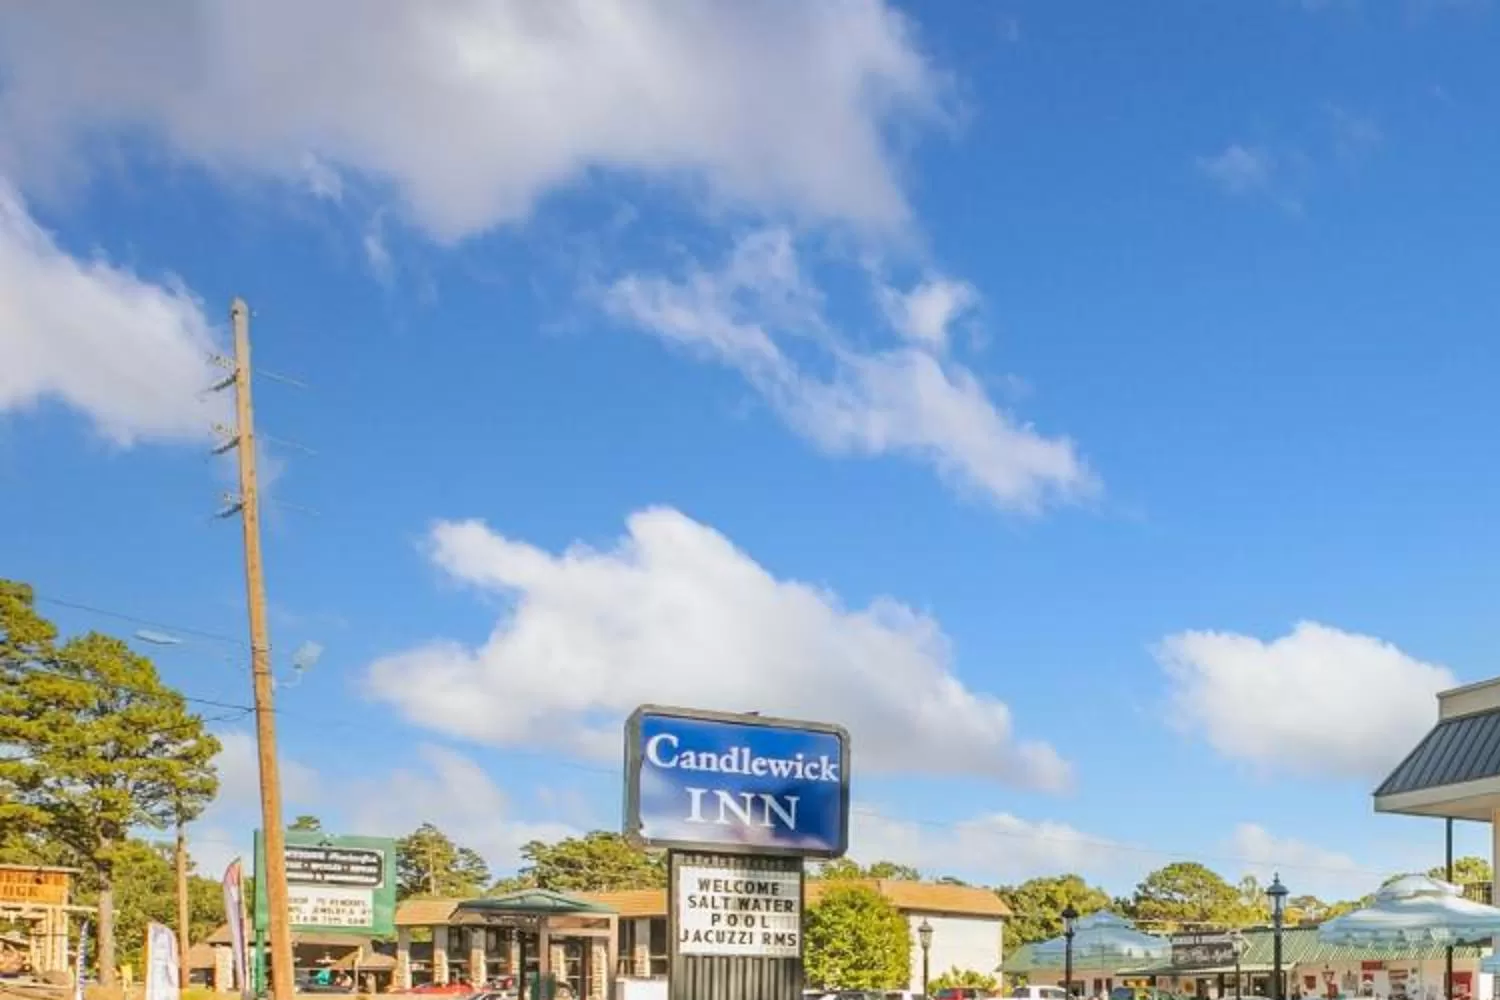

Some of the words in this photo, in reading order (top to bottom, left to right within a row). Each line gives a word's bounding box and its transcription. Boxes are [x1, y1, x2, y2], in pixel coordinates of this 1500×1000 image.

[646, 733, 840, 782] Candlewick
[684, 787, 801, 831] INN
[698, 879, 781, 896] WELCOME
[688, 895, 731, 910] SALT
[737, 897, 794, 912] WATER
[711, 913, 770, 928] POOL
[680, 929, 753, 944] JACUZZI
[761, 932, 797, 947] RMS
